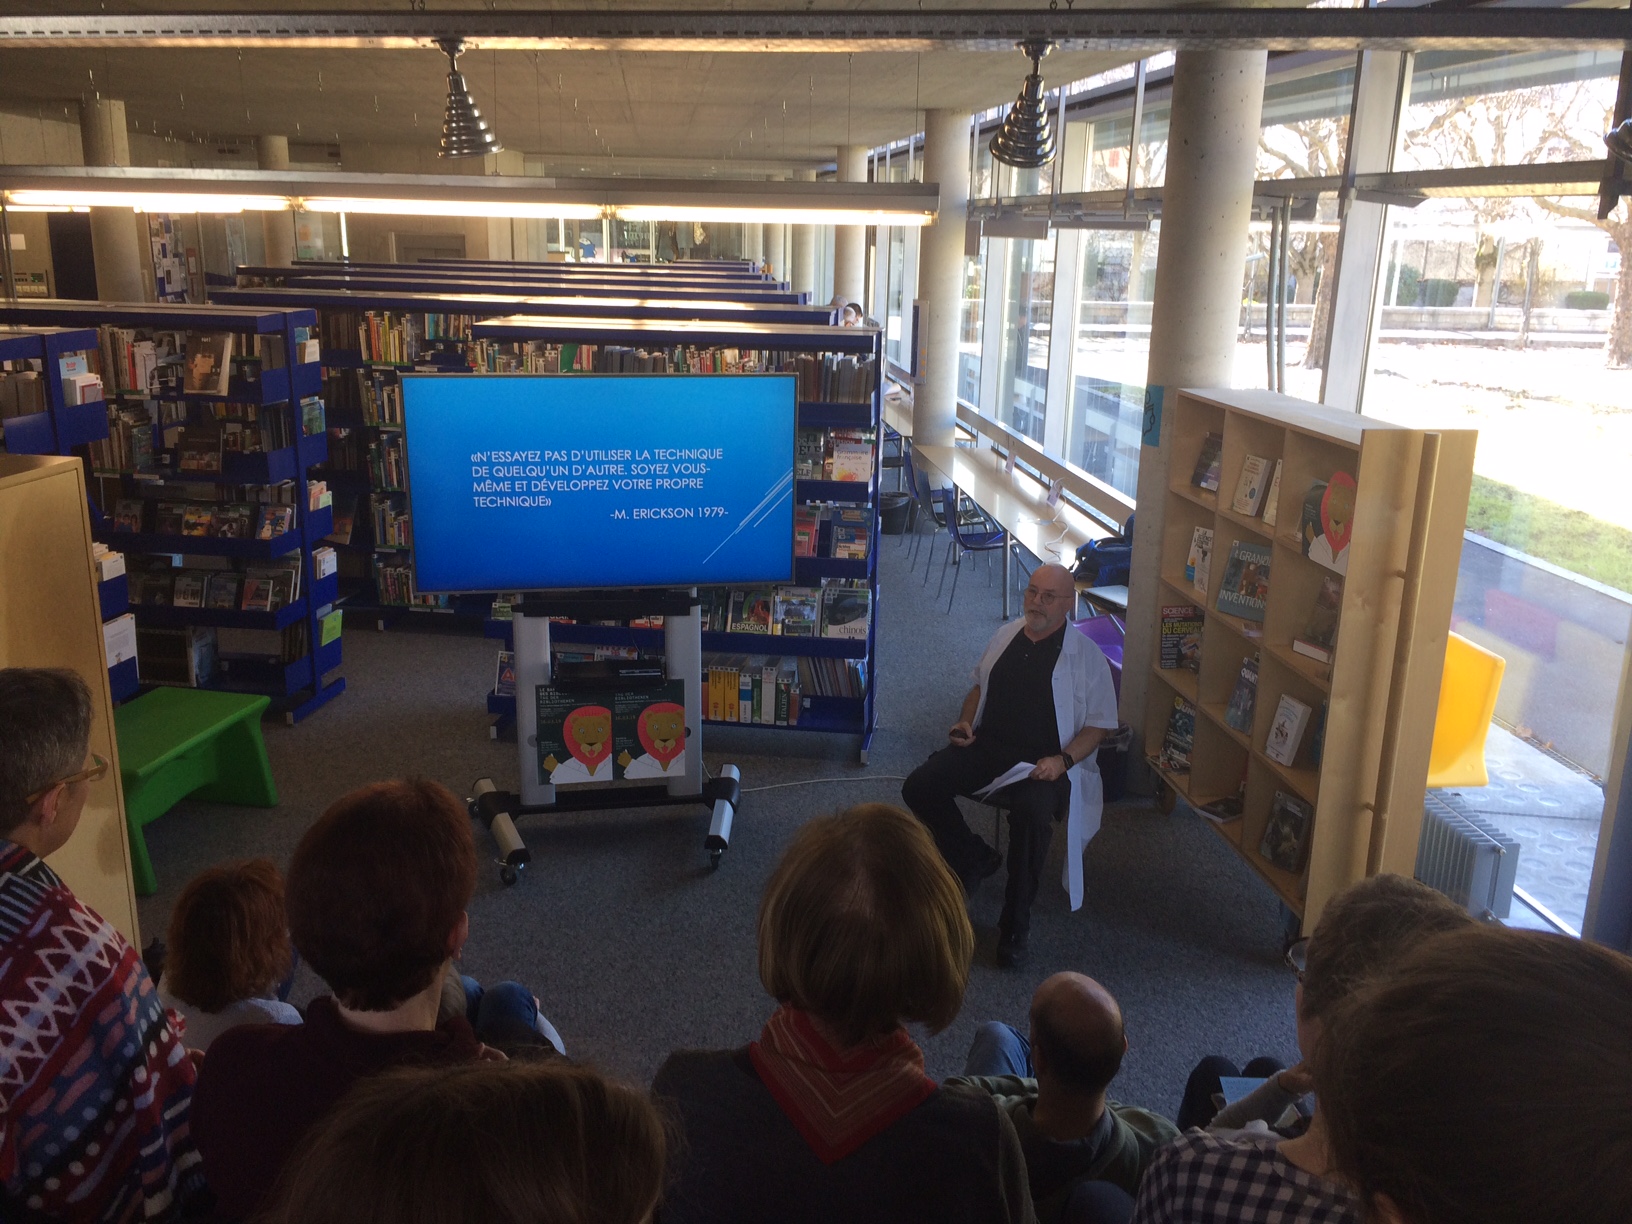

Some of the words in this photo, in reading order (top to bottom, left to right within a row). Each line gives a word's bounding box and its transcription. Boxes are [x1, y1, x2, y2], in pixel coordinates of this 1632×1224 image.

[544, 450, 568, 462] PAS
[571, 449, 632, 462] D'UTILISER
[635, 449, 651, 461] LA
[653, 448, 723, 461] TECHNIQUE
[472, 466, 489, 478] DE
[493, 464, 569, 478] QUELQU'UN
[572, 464, 627, 476] D'AUTRE.
[631, 463, 669, 475] SOYEZ
[672, 463, 711, 475] VOUS-
[473, 478, 512, 492] MÊME
[515, 480, 529, 492] ET
[531, 478, 609, 491] DÉVELOPPEZ
[612, 478, 652, 490] VOTRE
[655, 478, 704, 490] PROPRE
[633, 507, 694, 520] ERICKSON
[697, 507, 729, 519] 1979-
[1162, 607, 1194, 615] SCIENCE
[731, 622, 768, 632] ESPAGNOL
[838, 625, 867, 635] chinois
